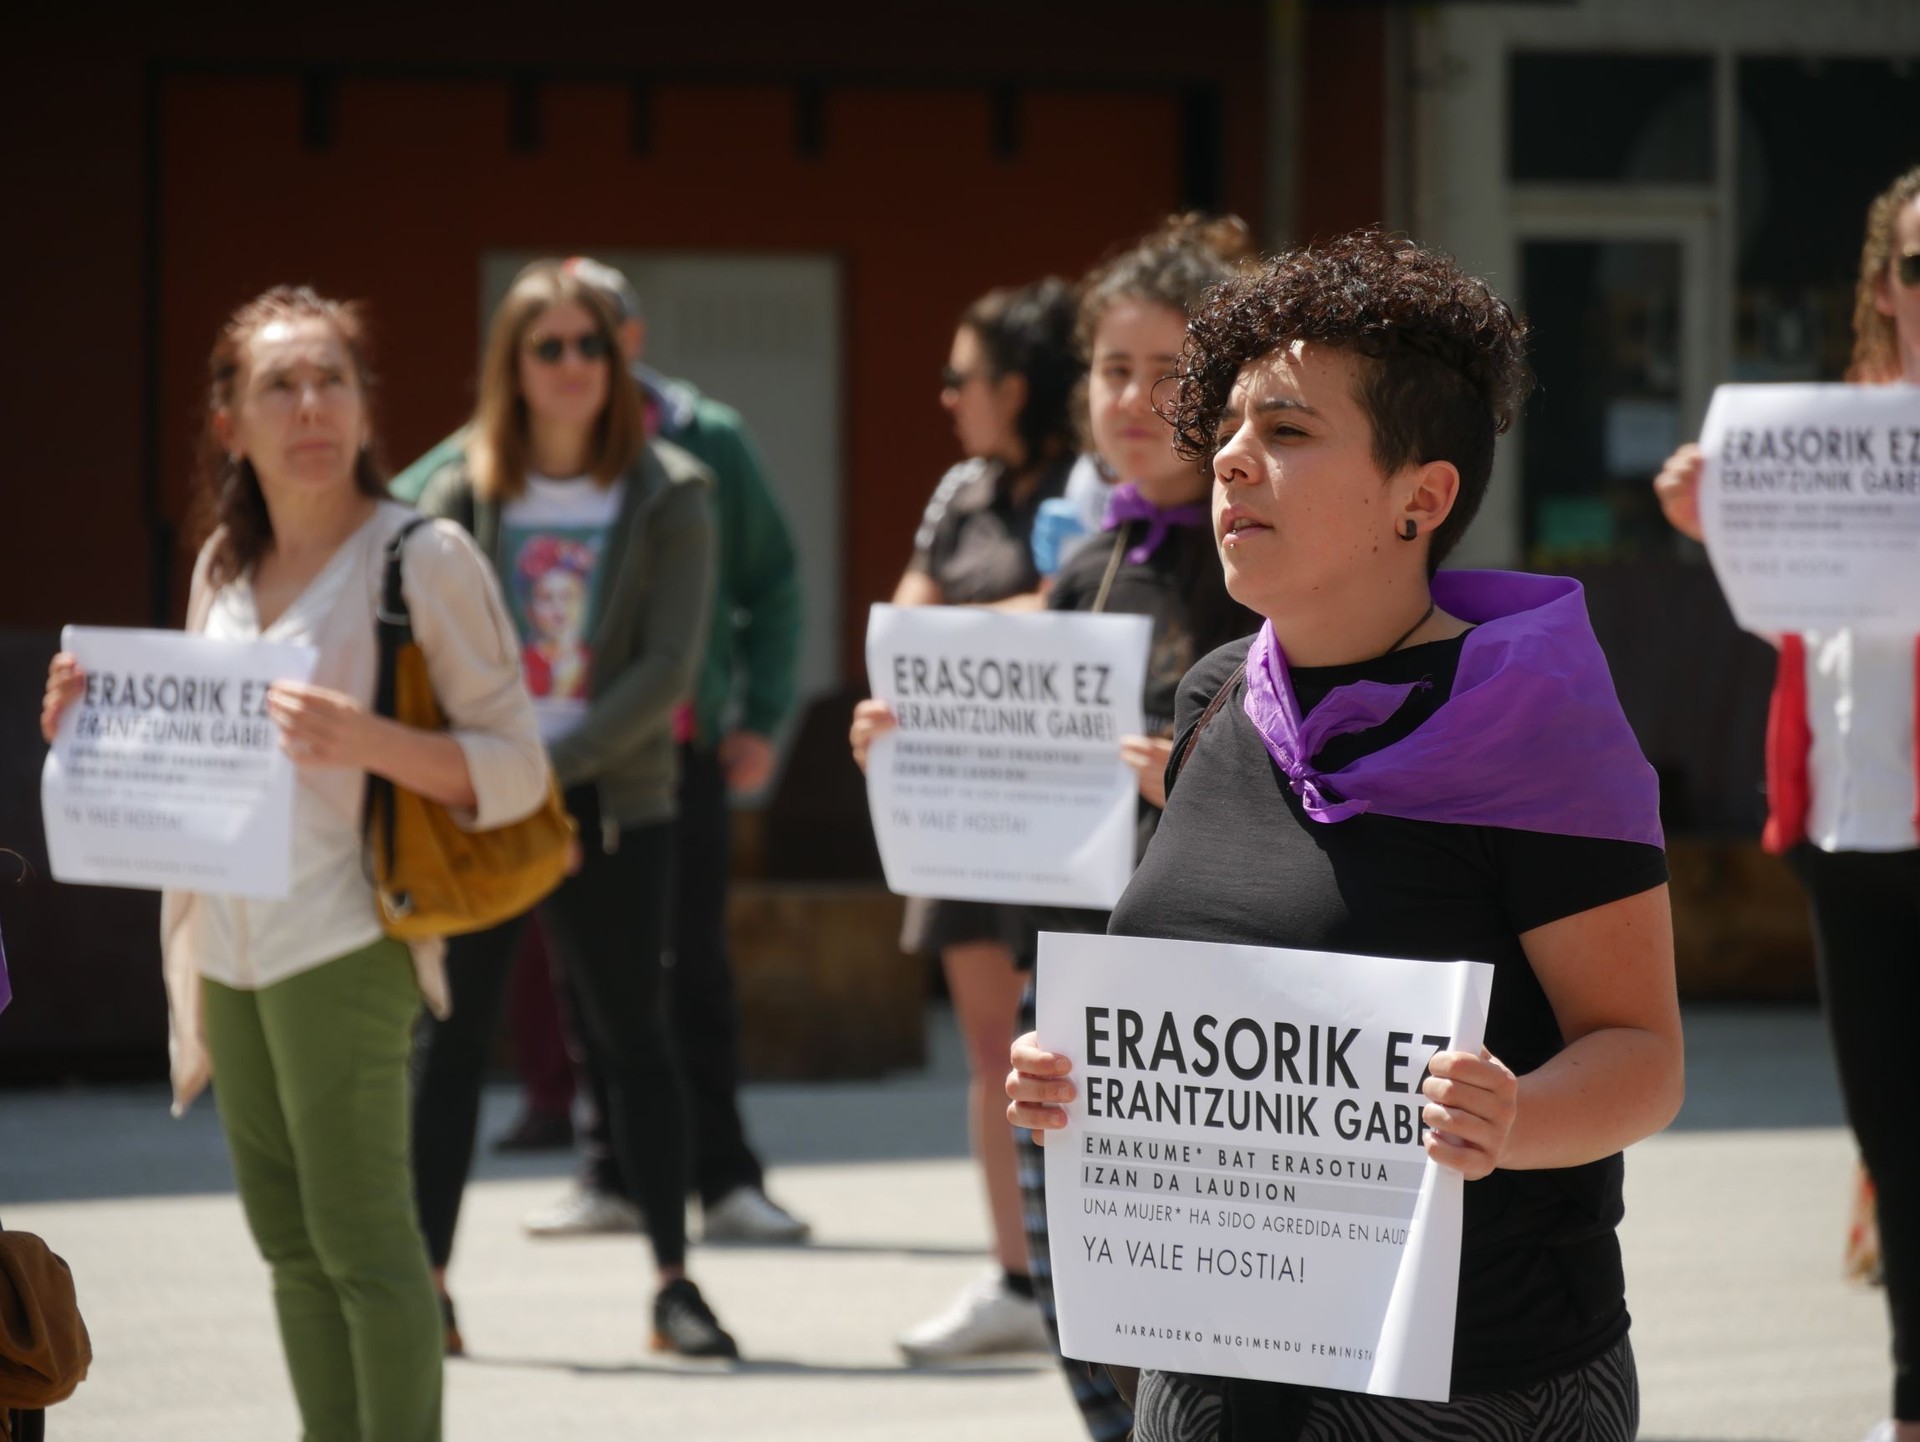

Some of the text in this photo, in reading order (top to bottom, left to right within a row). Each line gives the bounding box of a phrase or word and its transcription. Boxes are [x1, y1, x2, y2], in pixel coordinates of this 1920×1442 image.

[83, 671, 226, 716] ERASORIK
[892, 655, 1113, 706] ERASORIK EZ
[895, 702, 1038, 738] ERANTZUNIK
[1086, 1006, 1362, 1090] ERASORIK
[1087, 1076, 1319, 1137] ERANTZUNIK
[1085, 1166, 1296, 1203] IZAN DA LAUDION
[1218, 1150, 1256, 1169] BAT
[1272, 1154, 1388, 1182] ERASOTUA
[1083, 1198, 1118, 1217] UNA
[1189, 1207, 1211, 1226] HA
[1218, 1211, 1256, 1230] SIDO
[1262, 1215, 1342, 1239] AGREDIDA
[1349, 1223, 1370, 1241] EN
[1083, 1235, 1305, 1284] YA VALE HOSTIA!
[1115, 1323, 1204, 1343] AIARALDEKO
[1212, 1333, 1302, 1353] MUGIMENDU
